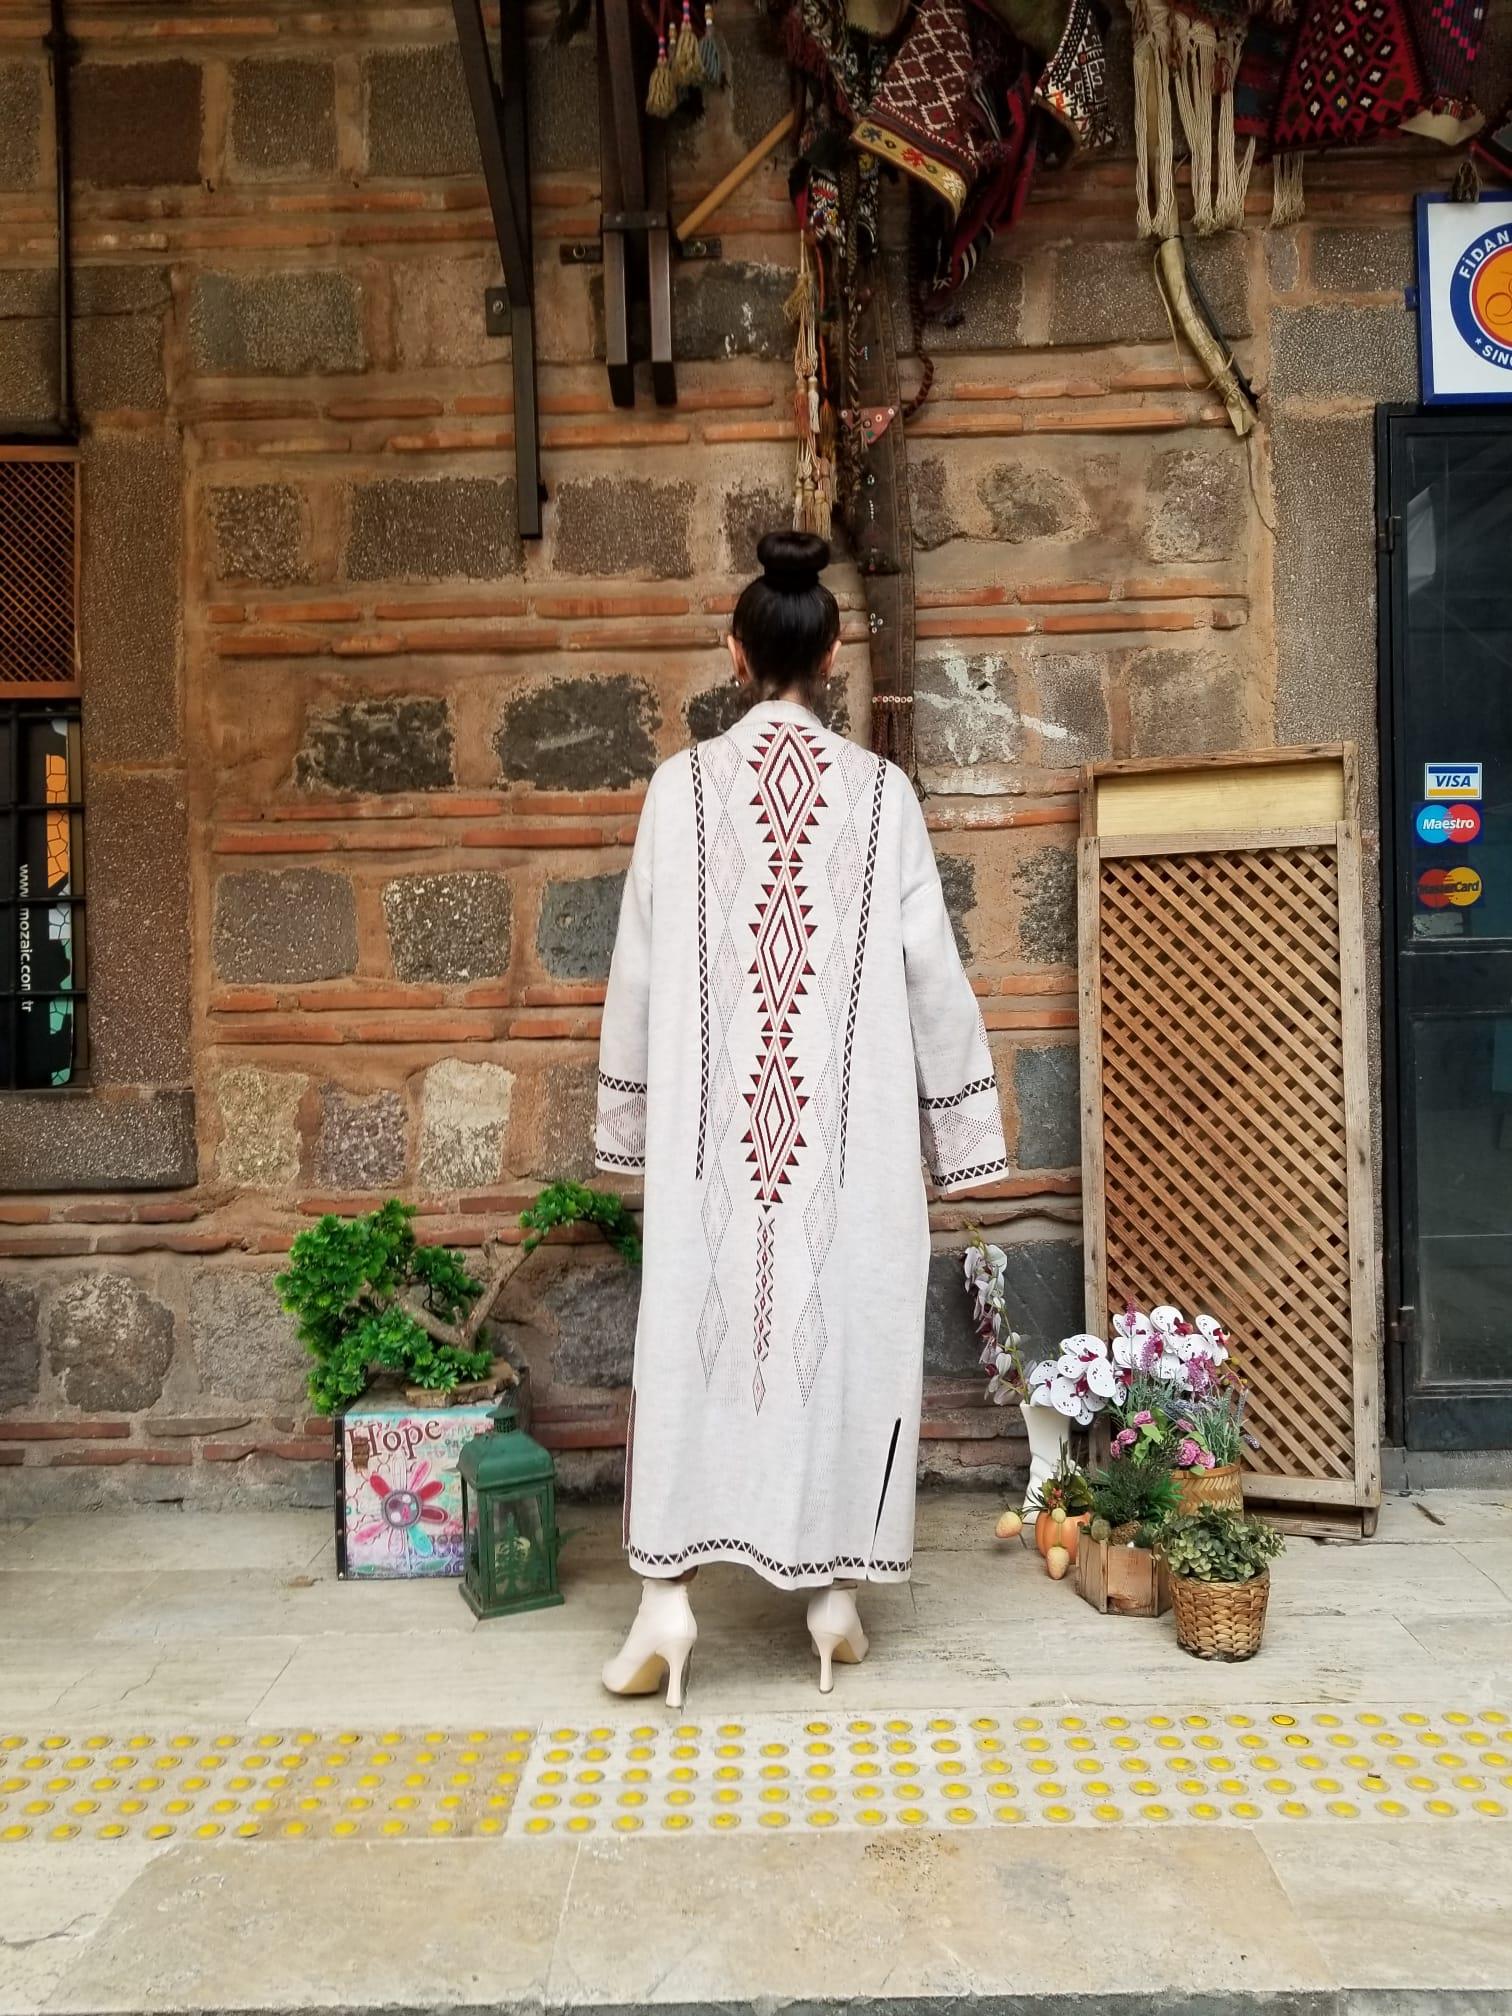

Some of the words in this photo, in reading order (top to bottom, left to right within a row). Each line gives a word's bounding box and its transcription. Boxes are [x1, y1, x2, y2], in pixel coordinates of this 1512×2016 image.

[1459, 230, 1510, 279] FİDAN
[1482, 345, 1512, 367] SIN
[1436, 775, 1471, 788] VISA
[1423, 817, 1475, 830] Maestro
[19, 864, 33, 1013] wwwmozaic.comtr
[345, 1420, 442, 1460] Hope
